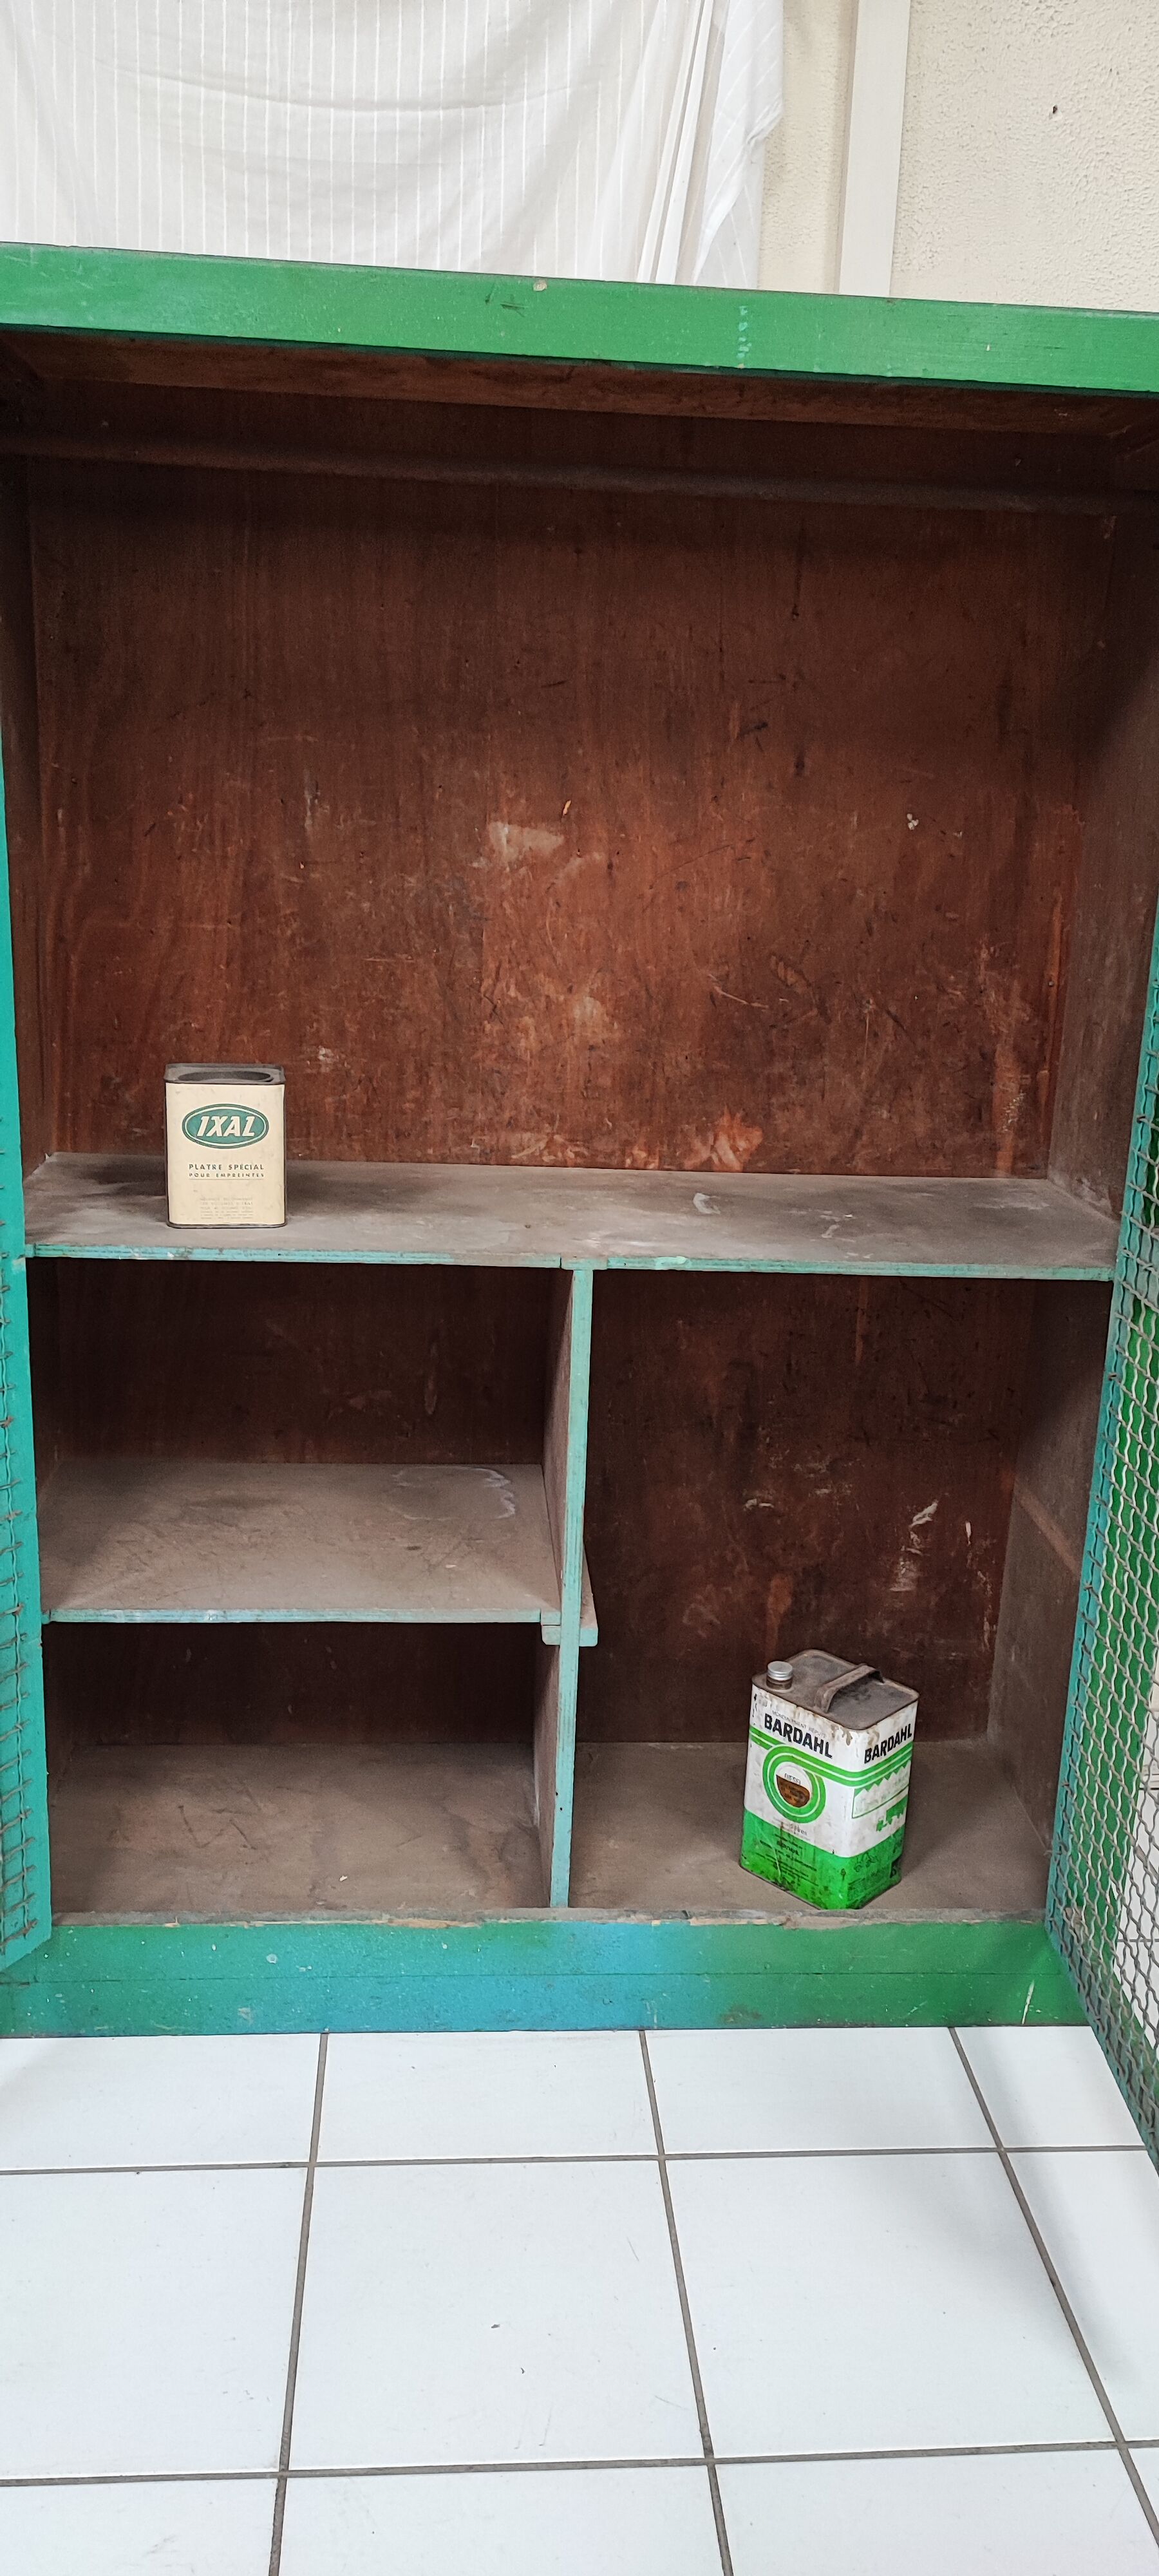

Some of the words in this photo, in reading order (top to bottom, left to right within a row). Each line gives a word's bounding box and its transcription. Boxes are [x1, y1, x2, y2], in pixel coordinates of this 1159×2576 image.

[196, 1116, 256, 1137] IXAL
[764, 1713, 833, 1759] BARDAHL
[864, 1723, 913, 1765] BARDAHL
